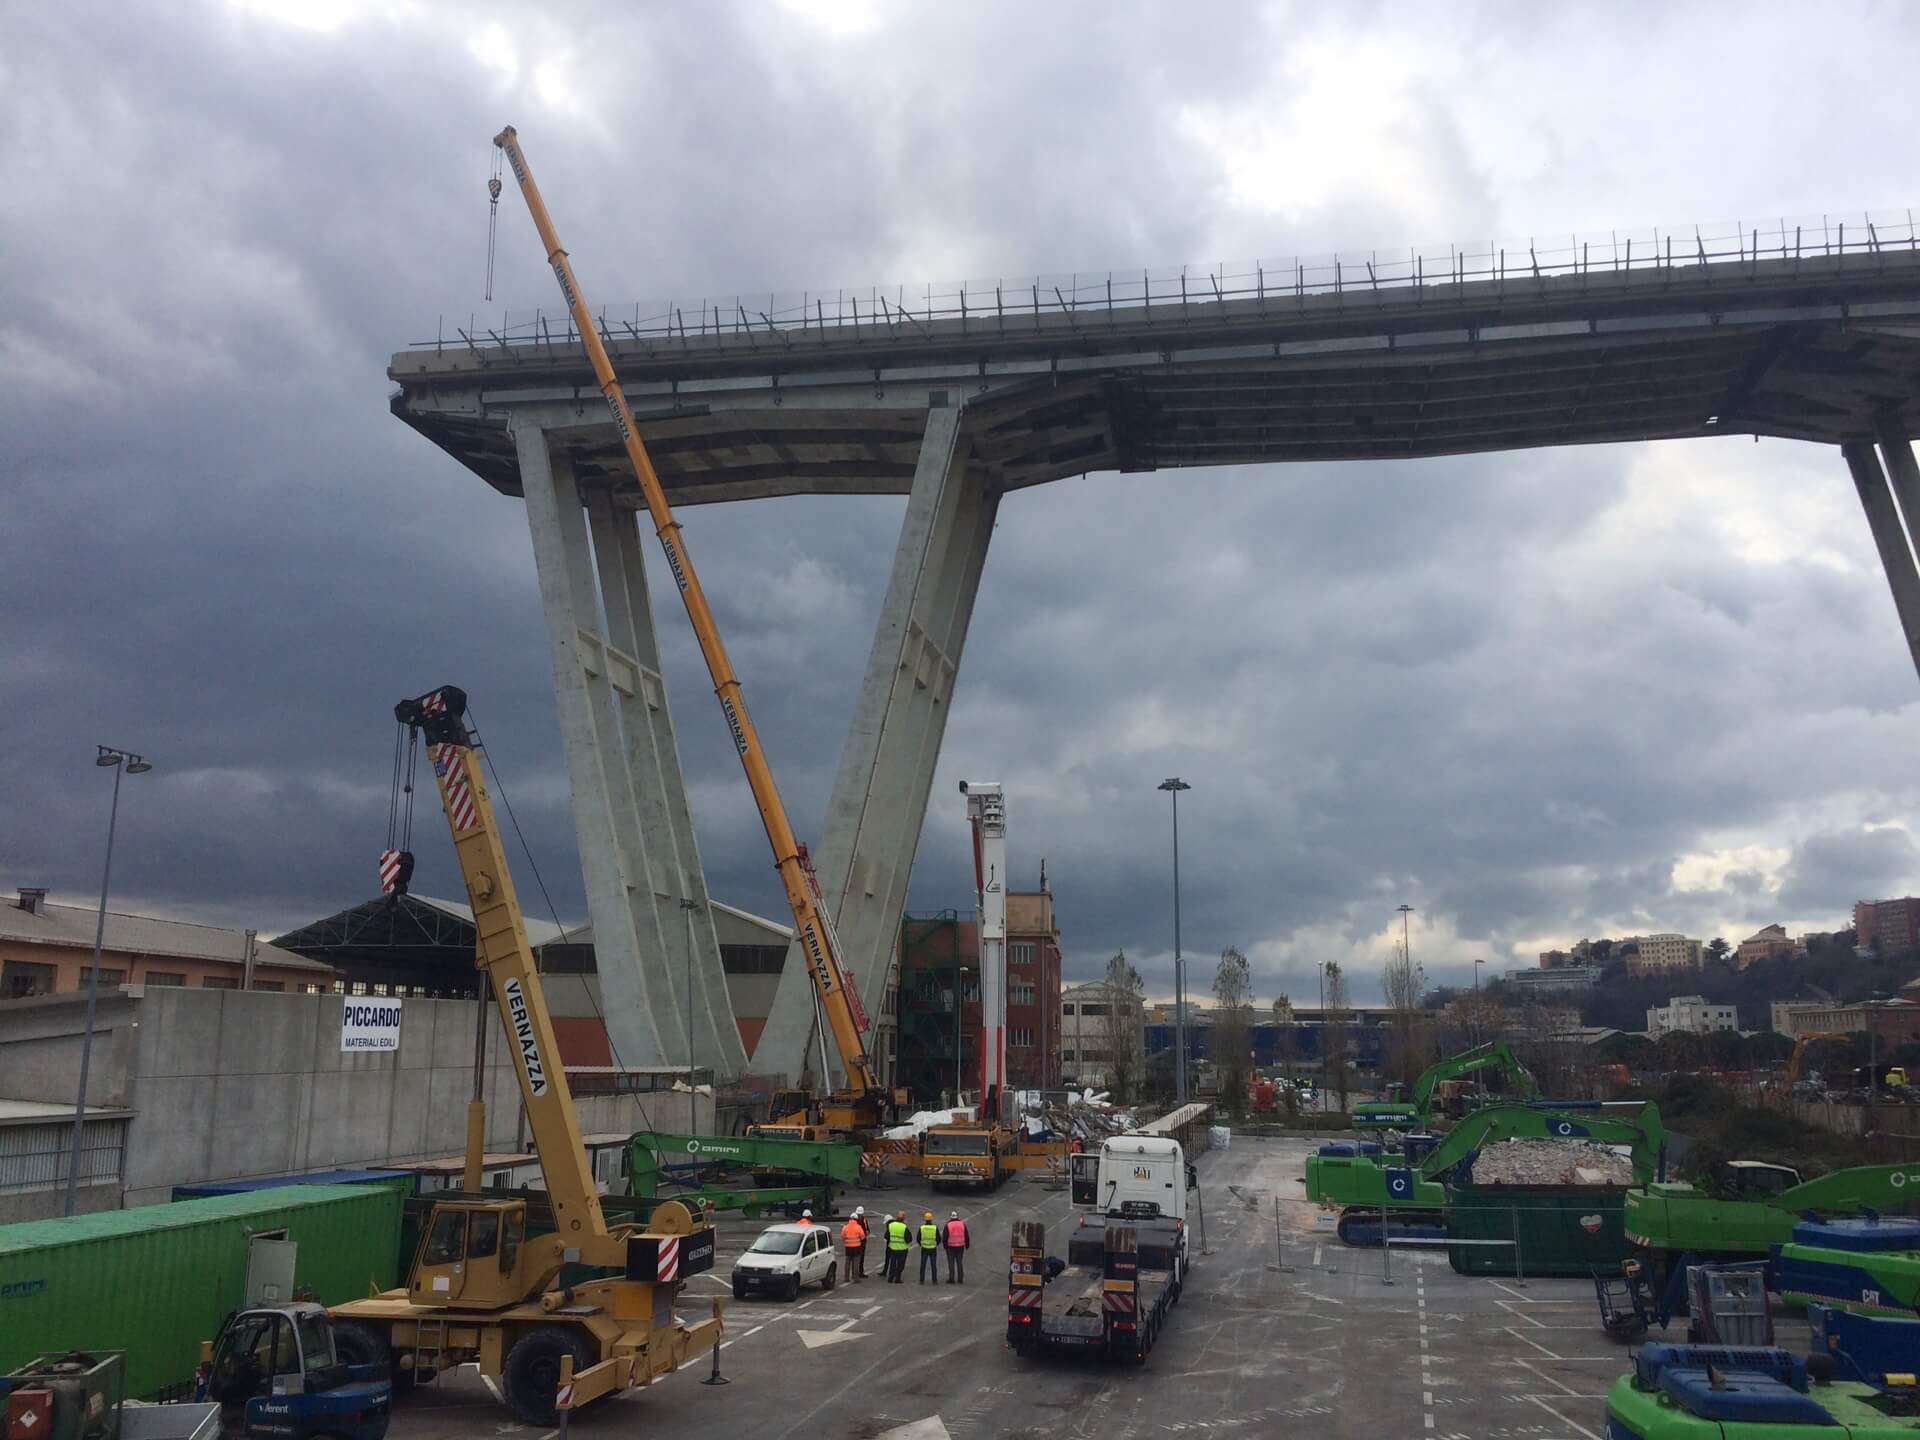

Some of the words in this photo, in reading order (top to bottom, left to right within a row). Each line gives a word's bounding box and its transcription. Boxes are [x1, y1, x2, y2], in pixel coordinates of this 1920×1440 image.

[665, 538, 688, 590] VERNAZZA
[725, 698, 748, 753] VERNAZZA
[805, 923, 832, 990] VERNAZZA
[344, 1006, 400, 1027] PICCARDO
[345, 1038, 378, 1047] MATERIALI
[380, 1038, 395, 1047] EDILI
[506, 982, 545, 1093] VERNAZZA
[1862, 1289, 1880, 1305] CAT
